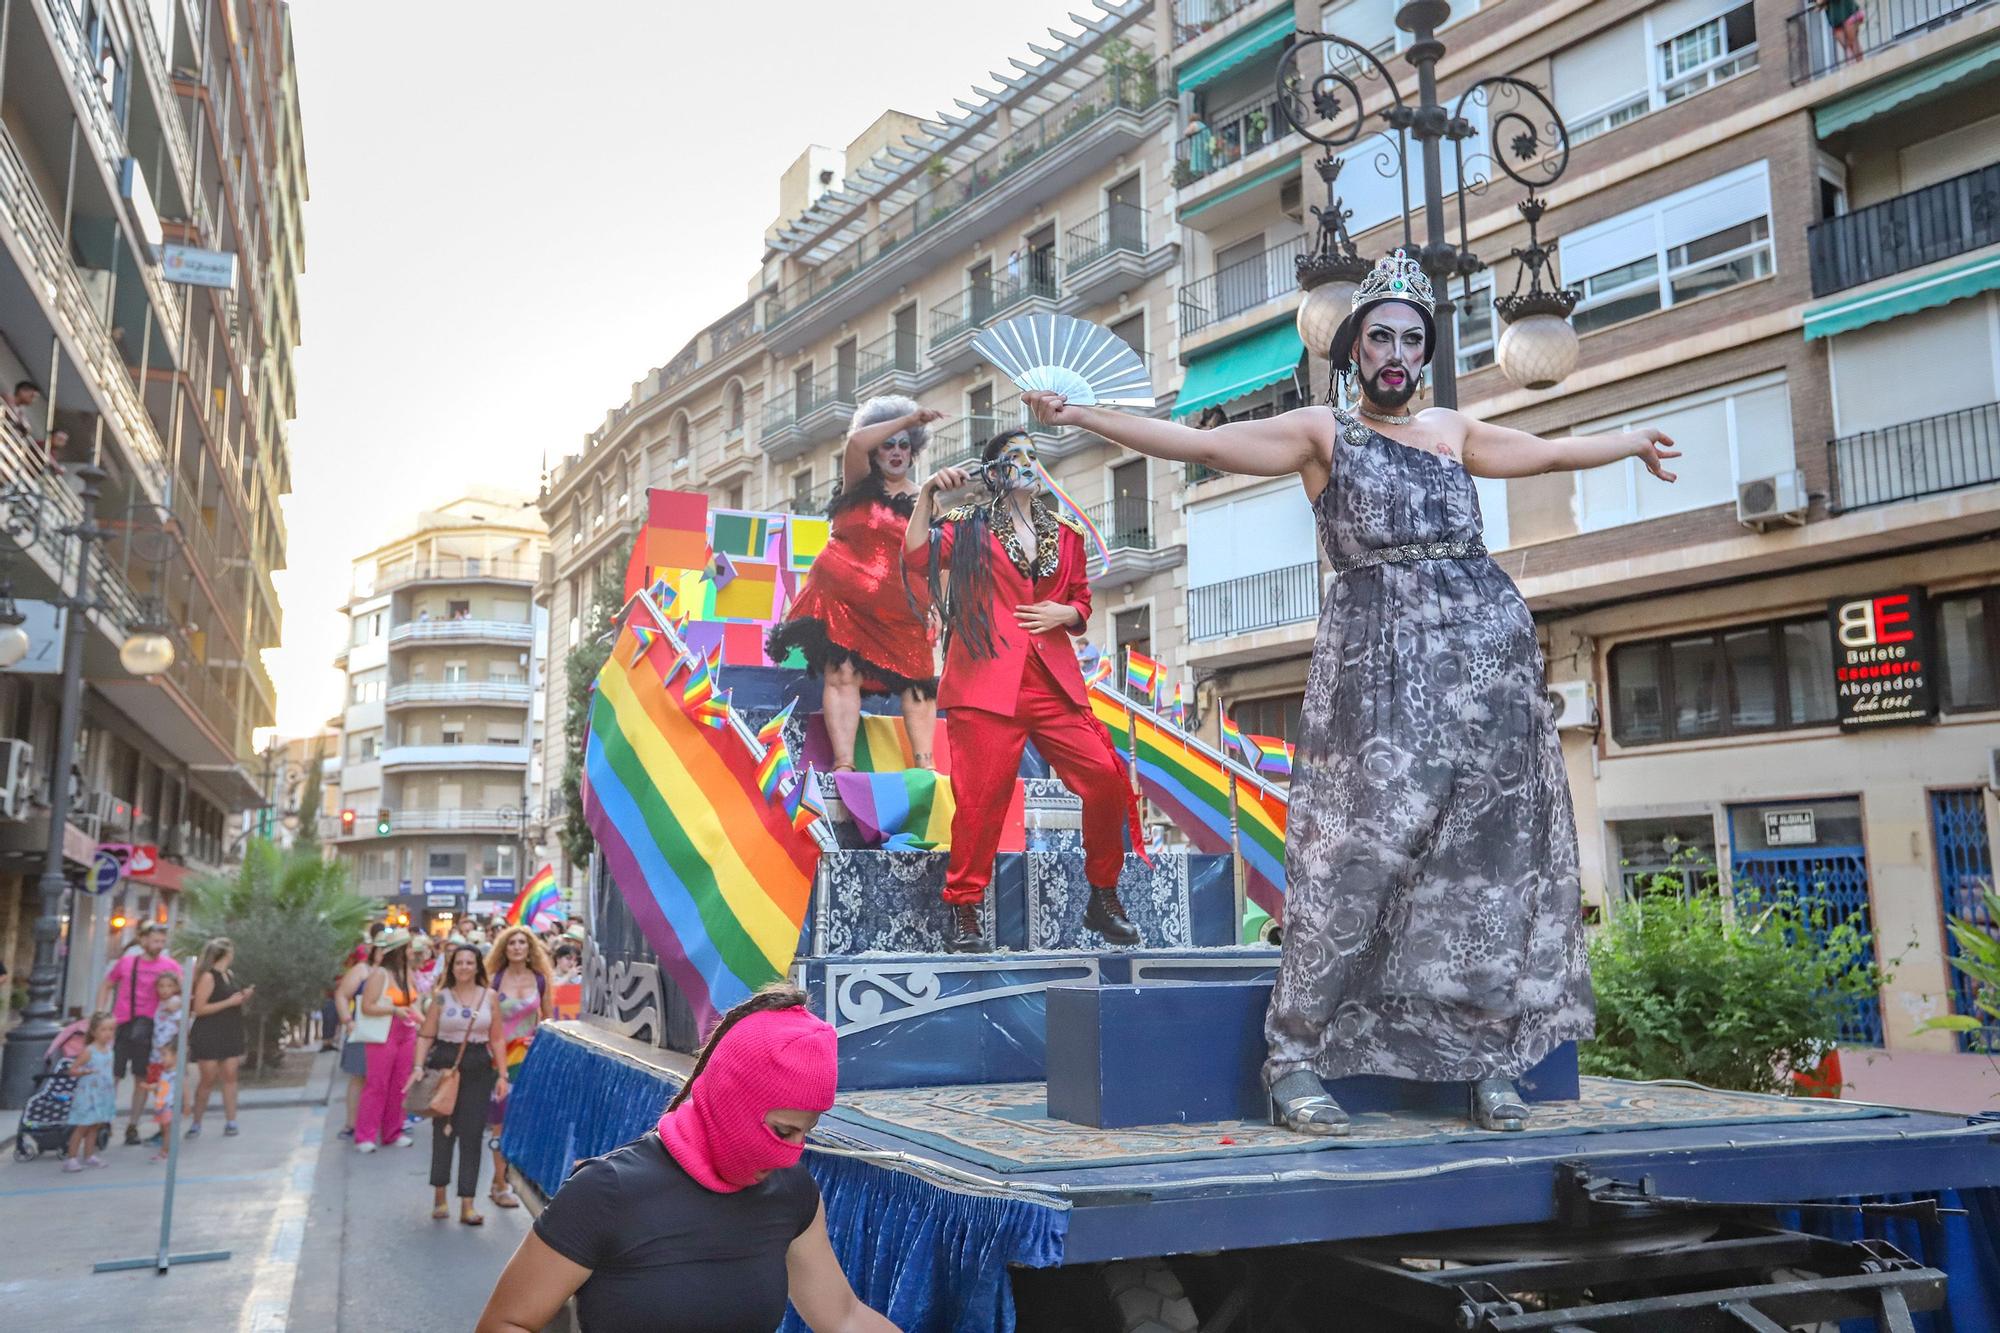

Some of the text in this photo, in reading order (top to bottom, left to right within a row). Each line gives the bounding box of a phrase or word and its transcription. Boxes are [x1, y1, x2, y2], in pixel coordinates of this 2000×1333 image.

[1847, 646, 1906, 664] Bufete
[1838, 661, 1921, 681] Escudero
[1840, 676, 1923, 696] Abogados
